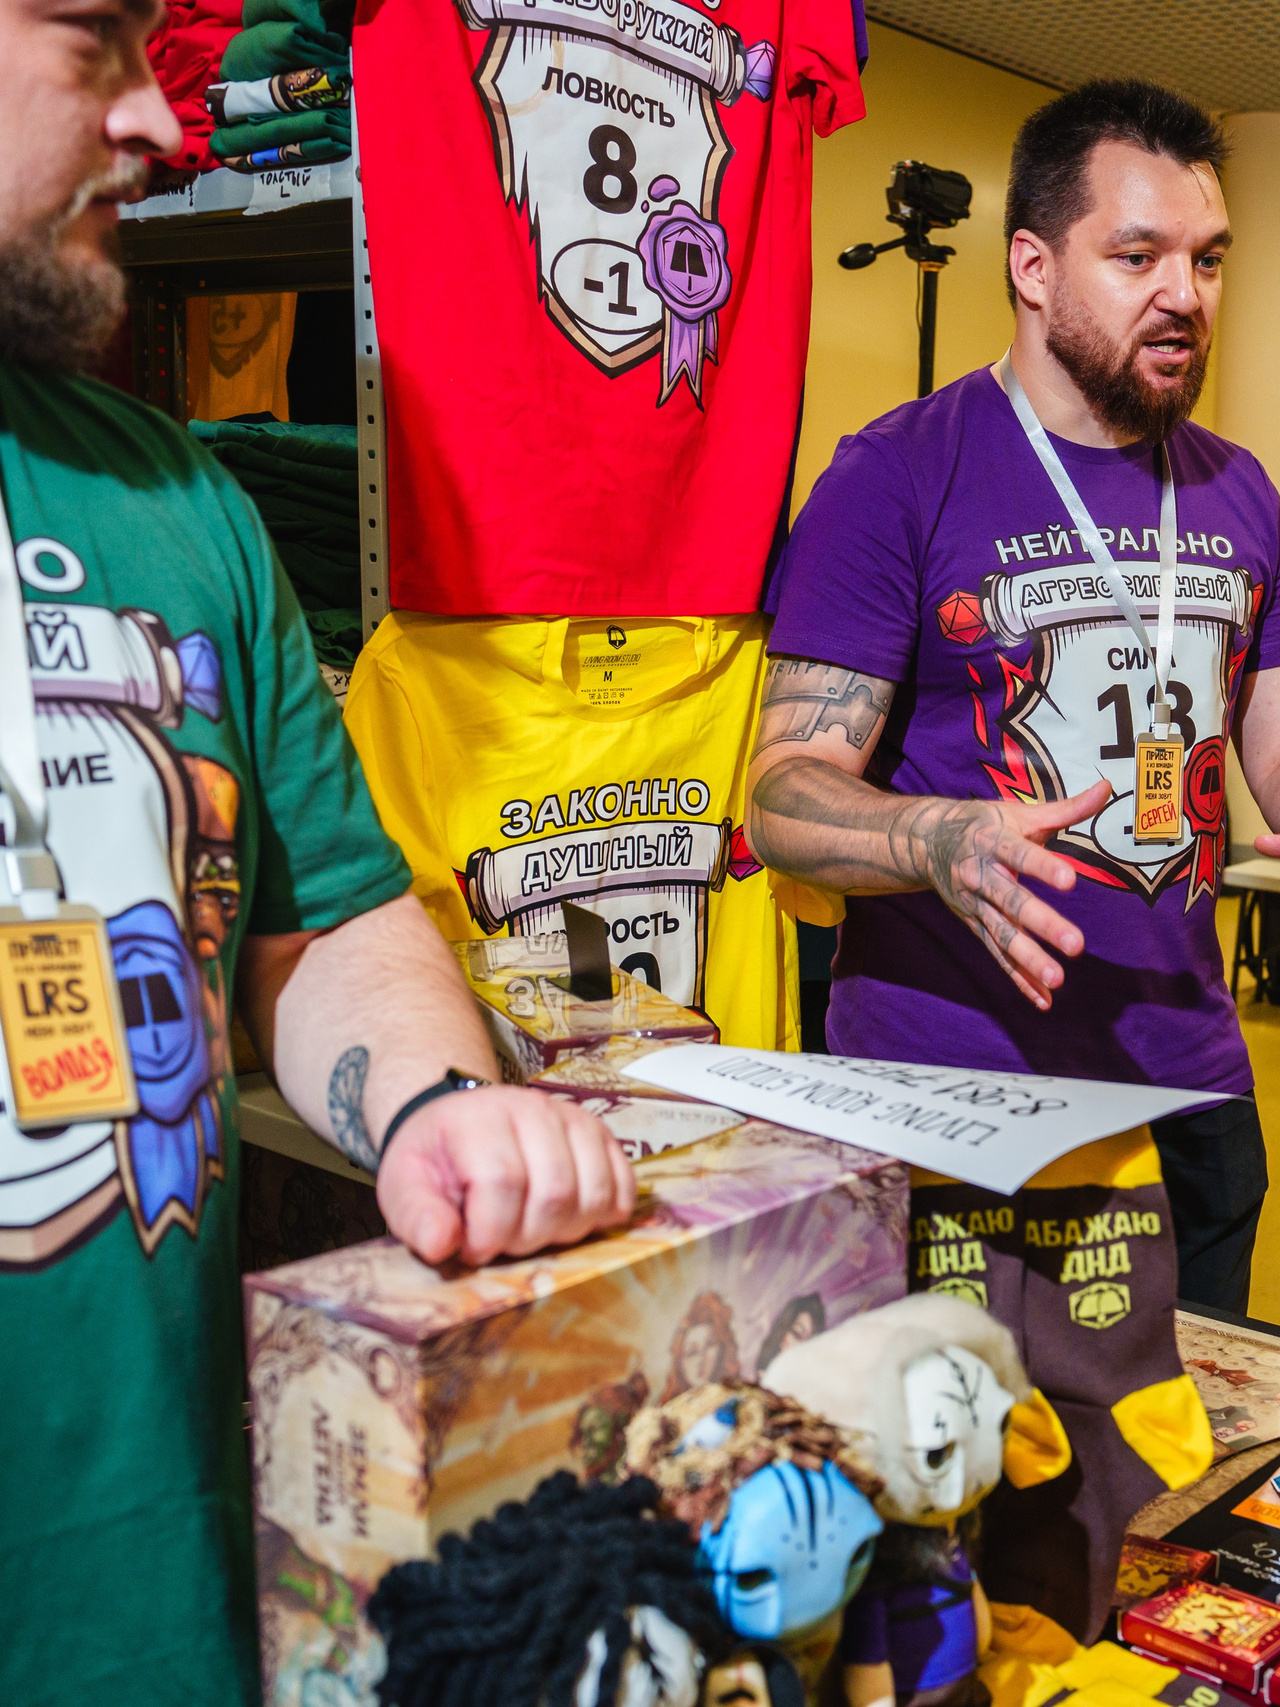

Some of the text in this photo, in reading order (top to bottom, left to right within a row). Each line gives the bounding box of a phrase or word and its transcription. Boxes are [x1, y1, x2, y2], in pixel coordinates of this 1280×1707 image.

[541, 66, 676, 128] ЛОВКОСТЬ
[260, 168, 312, 187] ТОЛСТЫЙ
[583, 124, 638, 214] 8
[280, 185, 290, 198] L
[583, 261, 637, 316] -1
[603, 671, 612, 682] M
[1107, 647, 1177, 671] СИЛ
[1146, 751, 1174, 761] ПРИВЕТ!
[1146, 771, 1173, 791] LRS
[500, 778, 711, 839] ЗАКОННО
[1140, 800, 1178, 831] СЕРГЕЙ
[521, 825, 694, 897] ДУШНЫЙ
[20, 978, 88, 1016] LRS
[787, 1080, 882, 1116] ROOM
[872, 1099, 1001, 1148] LIVING
[1024, 1211, 1161, 1248] АБАЖАЮ
[917, 1240, 987, 1278] ДНД
[1060, 1241, 1132, 1284] ДНД
